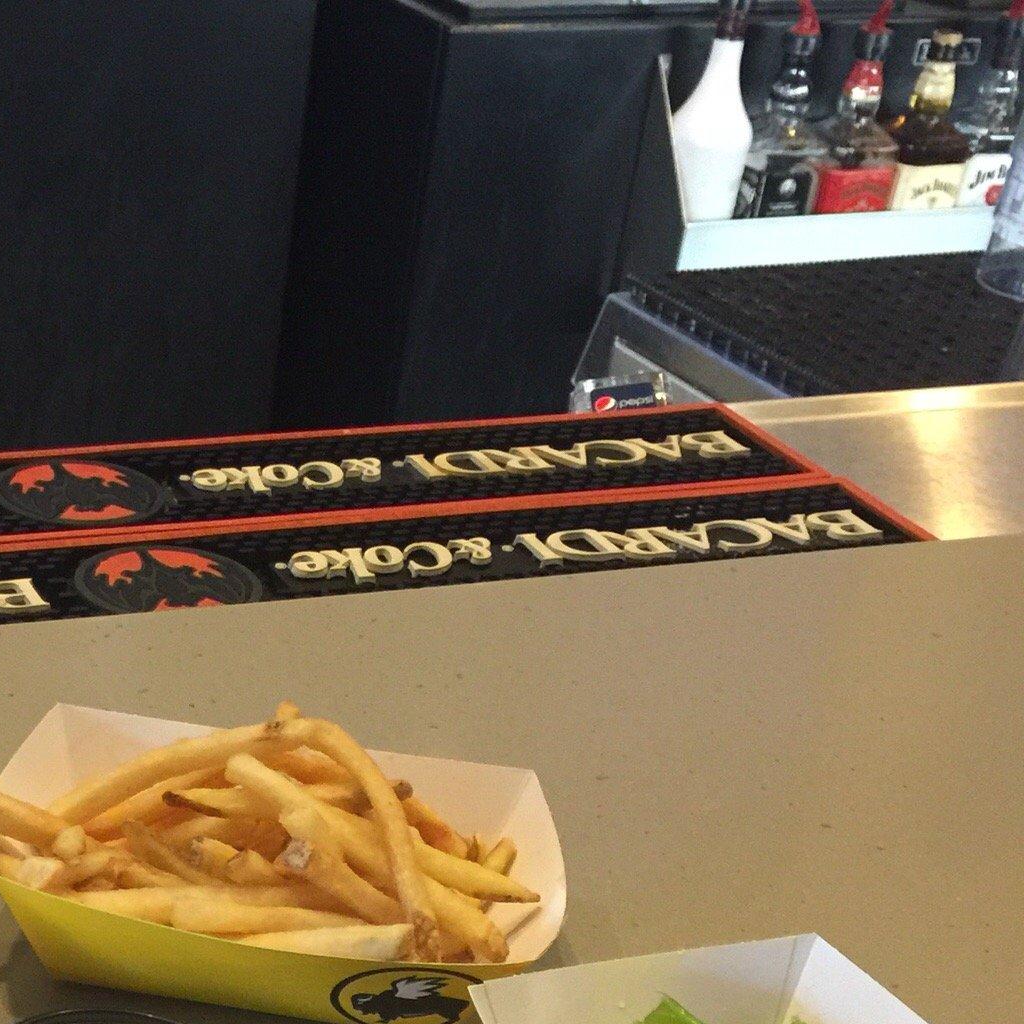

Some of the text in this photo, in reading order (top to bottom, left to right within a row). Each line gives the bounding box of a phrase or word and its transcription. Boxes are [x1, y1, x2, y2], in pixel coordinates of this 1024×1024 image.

[619, 395, 654, 409] pepsi
[404, 430, 751, 481] BACARDI
[513, 509, 883, 568] BACARDI
